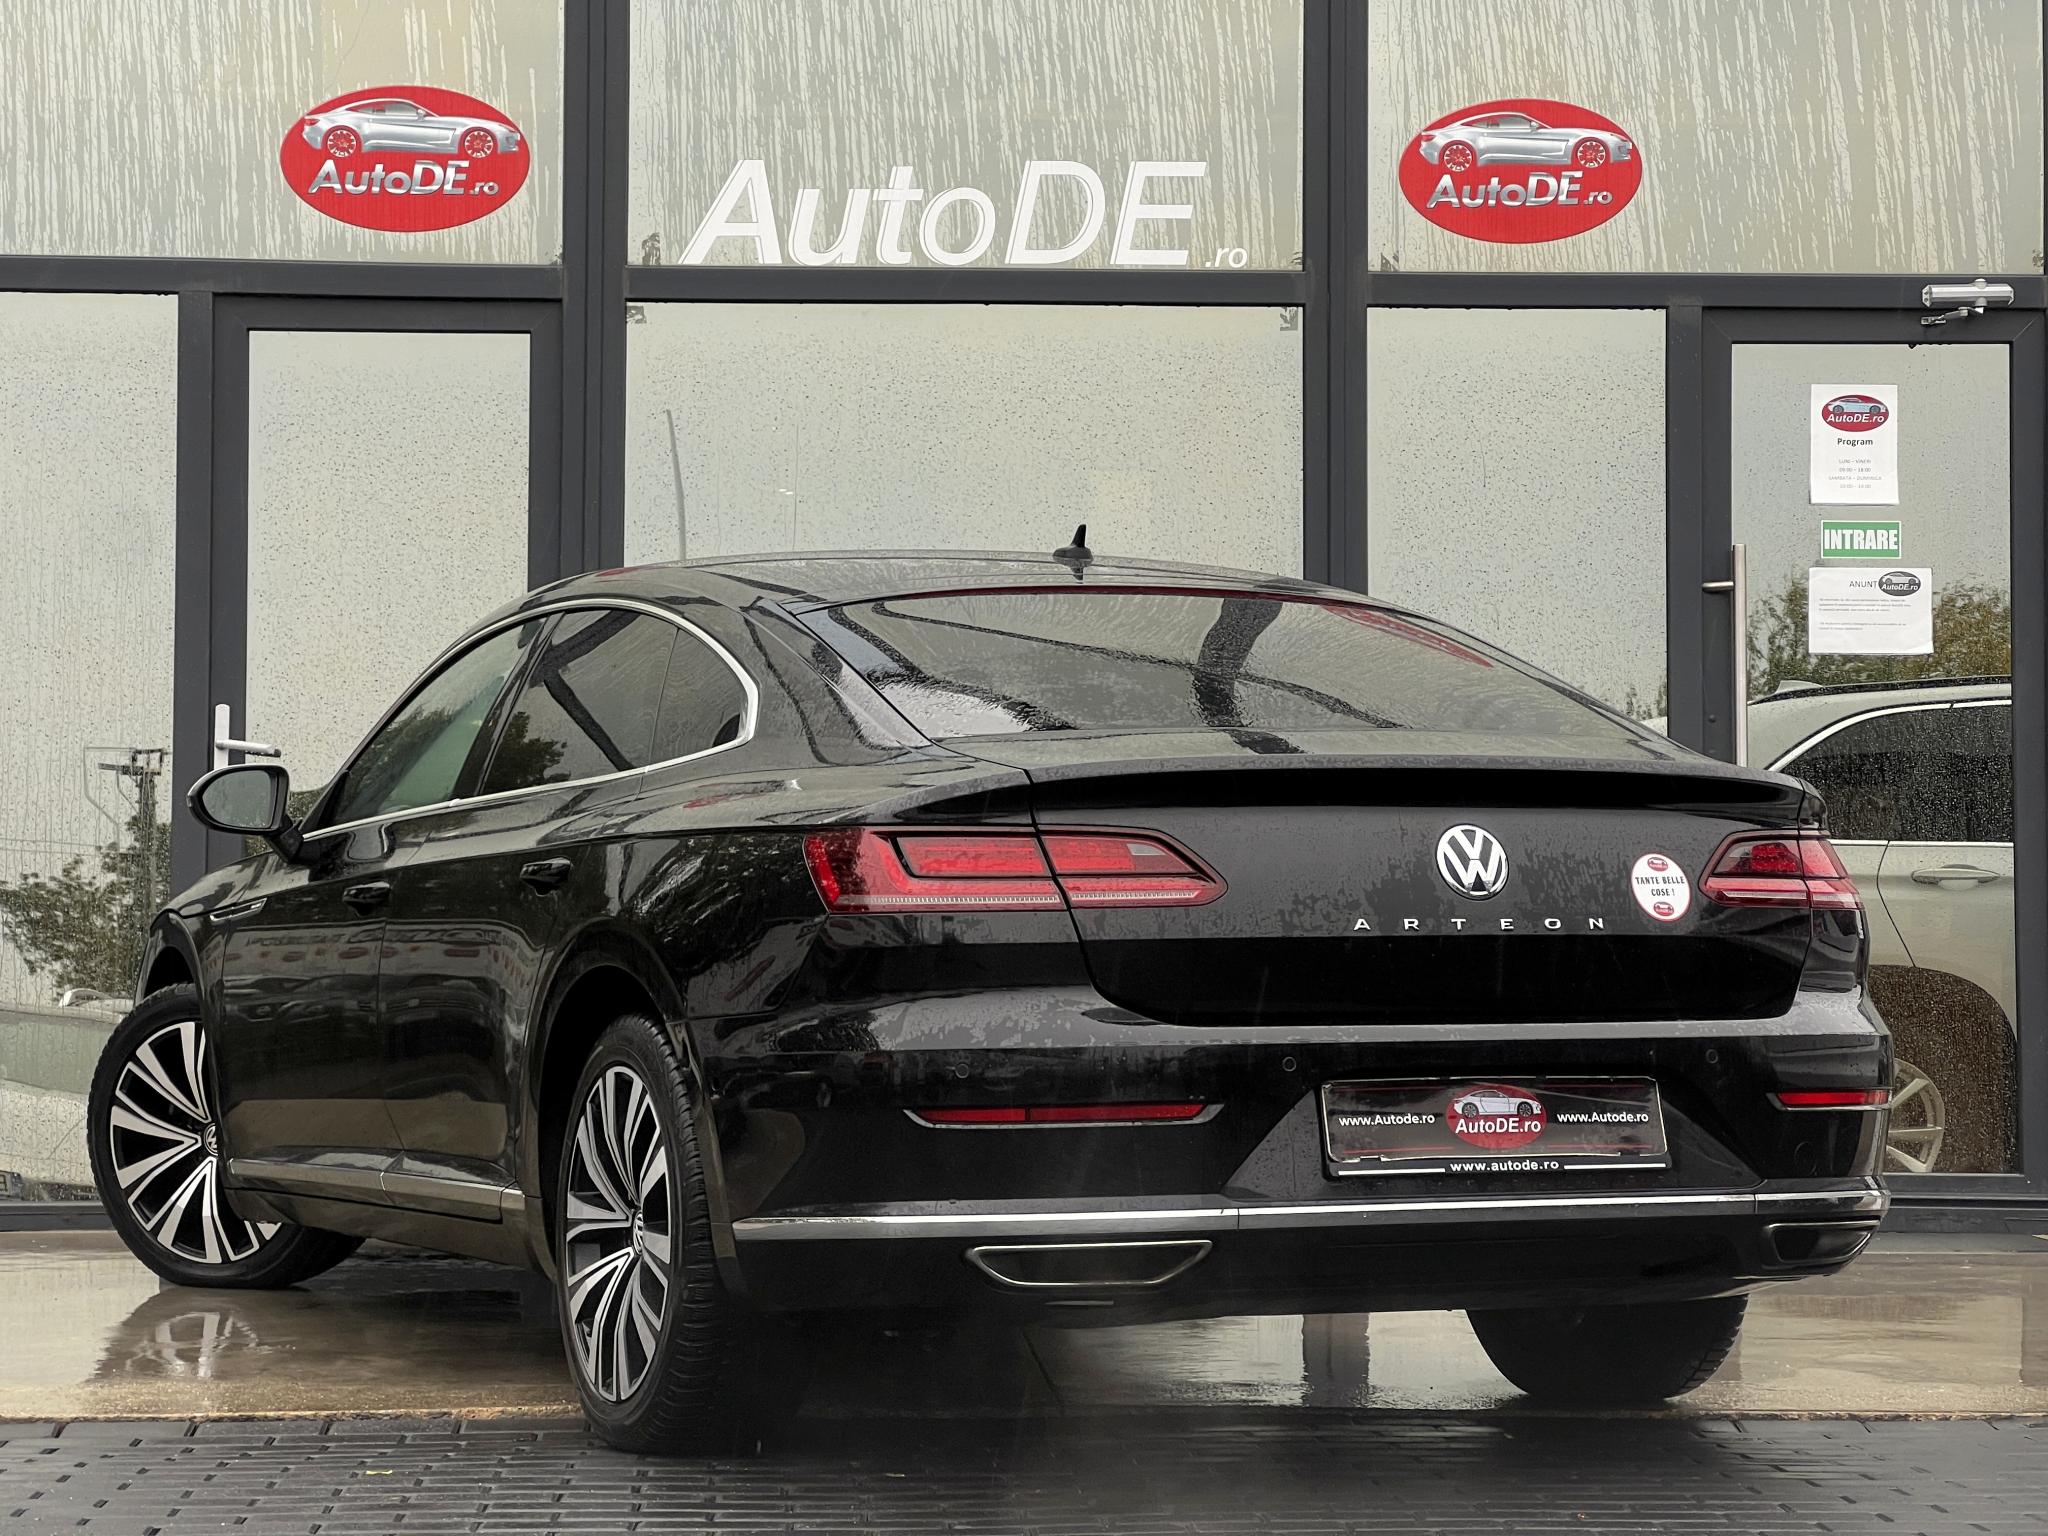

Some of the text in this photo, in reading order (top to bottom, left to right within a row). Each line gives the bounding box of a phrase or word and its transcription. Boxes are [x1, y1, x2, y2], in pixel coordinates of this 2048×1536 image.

[1827, 413, 1885, 423] AutoDE.ro
[1837, 437, 1873, 447] Program
[1823, 529, 1898, 550] INTRARE
[1635, 876, 1685, 885] TANTE BELLE
[1651, 888, 1670, 897] COSE
[1353, 917, 1604, 931] ARTEON
[1338, 1113, 1436, 1127] www.Autode.ro
[1556, 1111, 1649, 1124] www.Autode.ro
[1455, 1117, 1541, 1134] AutoDE.ro
[1450, 1159, 1560, 1172] www.autode.ro
